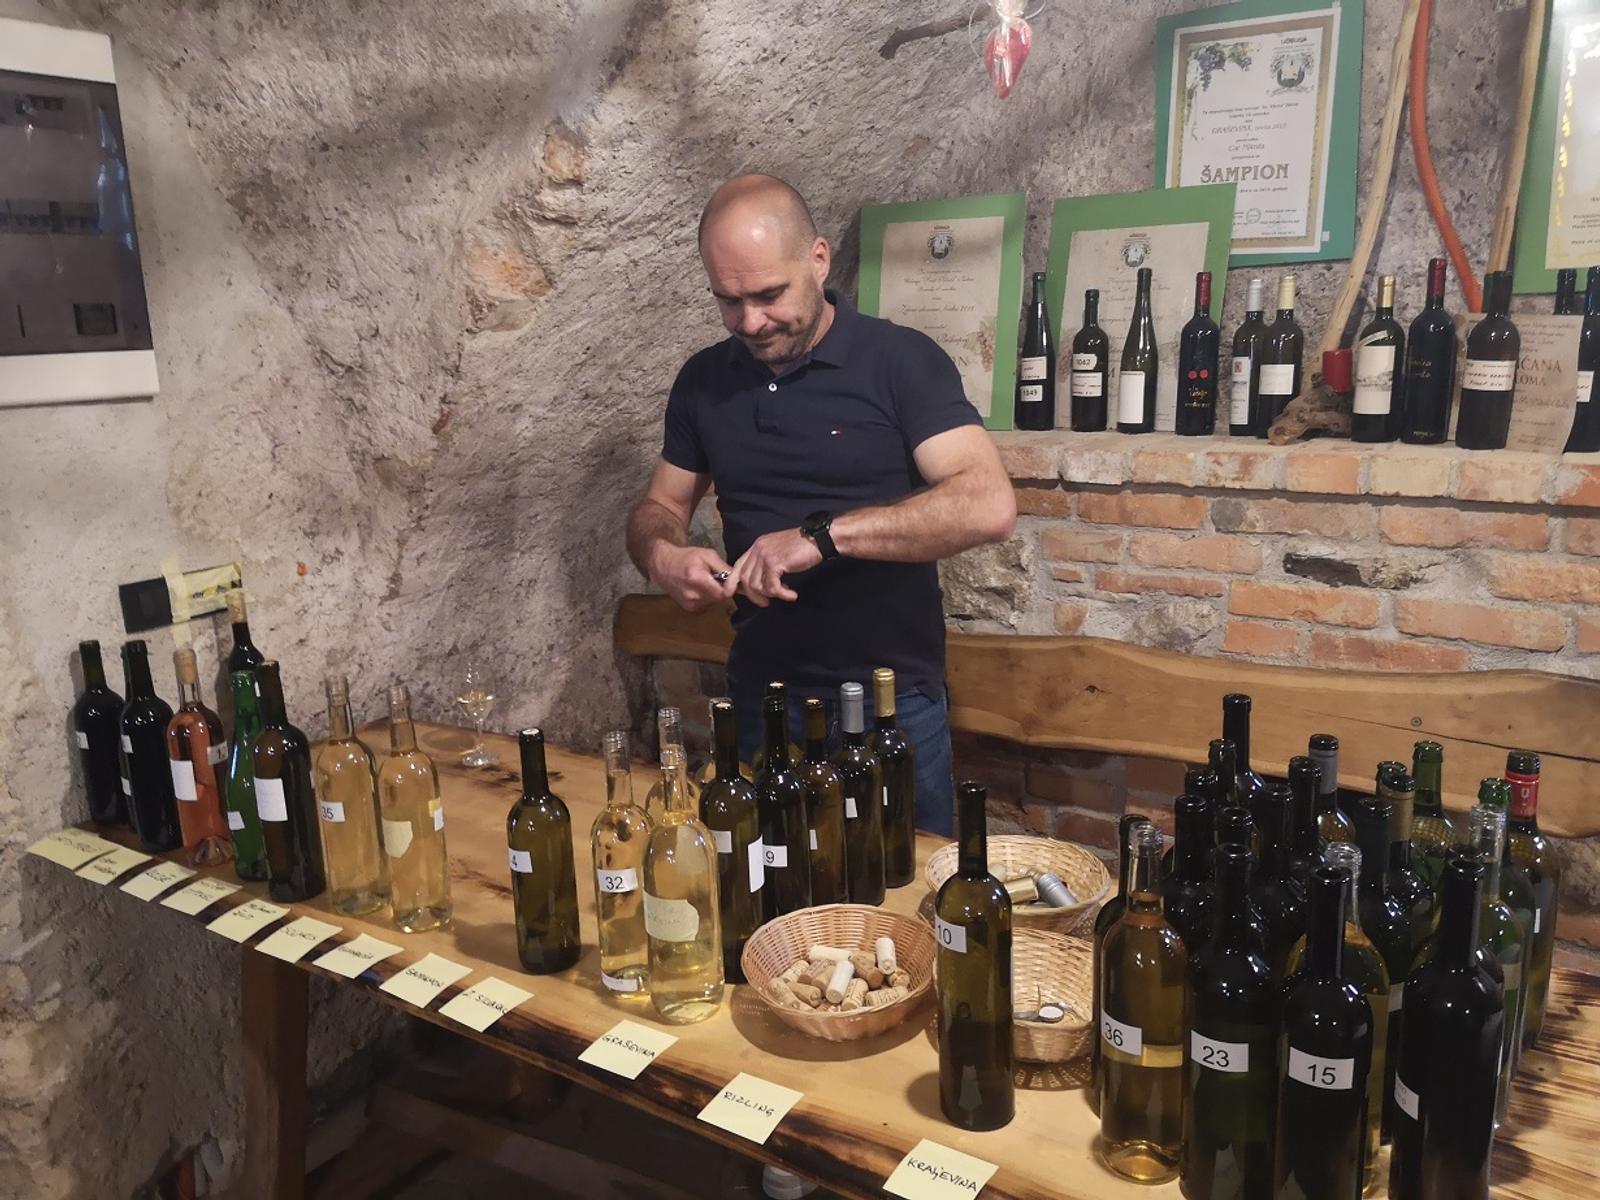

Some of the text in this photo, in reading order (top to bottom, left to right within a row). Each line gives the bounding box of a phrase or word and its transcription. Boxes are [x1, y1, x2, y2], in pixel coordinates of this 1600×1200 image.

[1200, 163, 1289, 183] ŠAMPION
[321, 806, 334, 820] 35
[605, 876, 624, 890] 32
[938, 924, 952, 945] 10
[601, 1033, 656, 1058] GRAŠEVINA
[1104, 1022, 1124, 1047] 36
[1202, 1045, 1231, 1068] 23
[1306, 1063, 1337, 1086] 15
[723, 1090, 775, 1117] RIZLING
